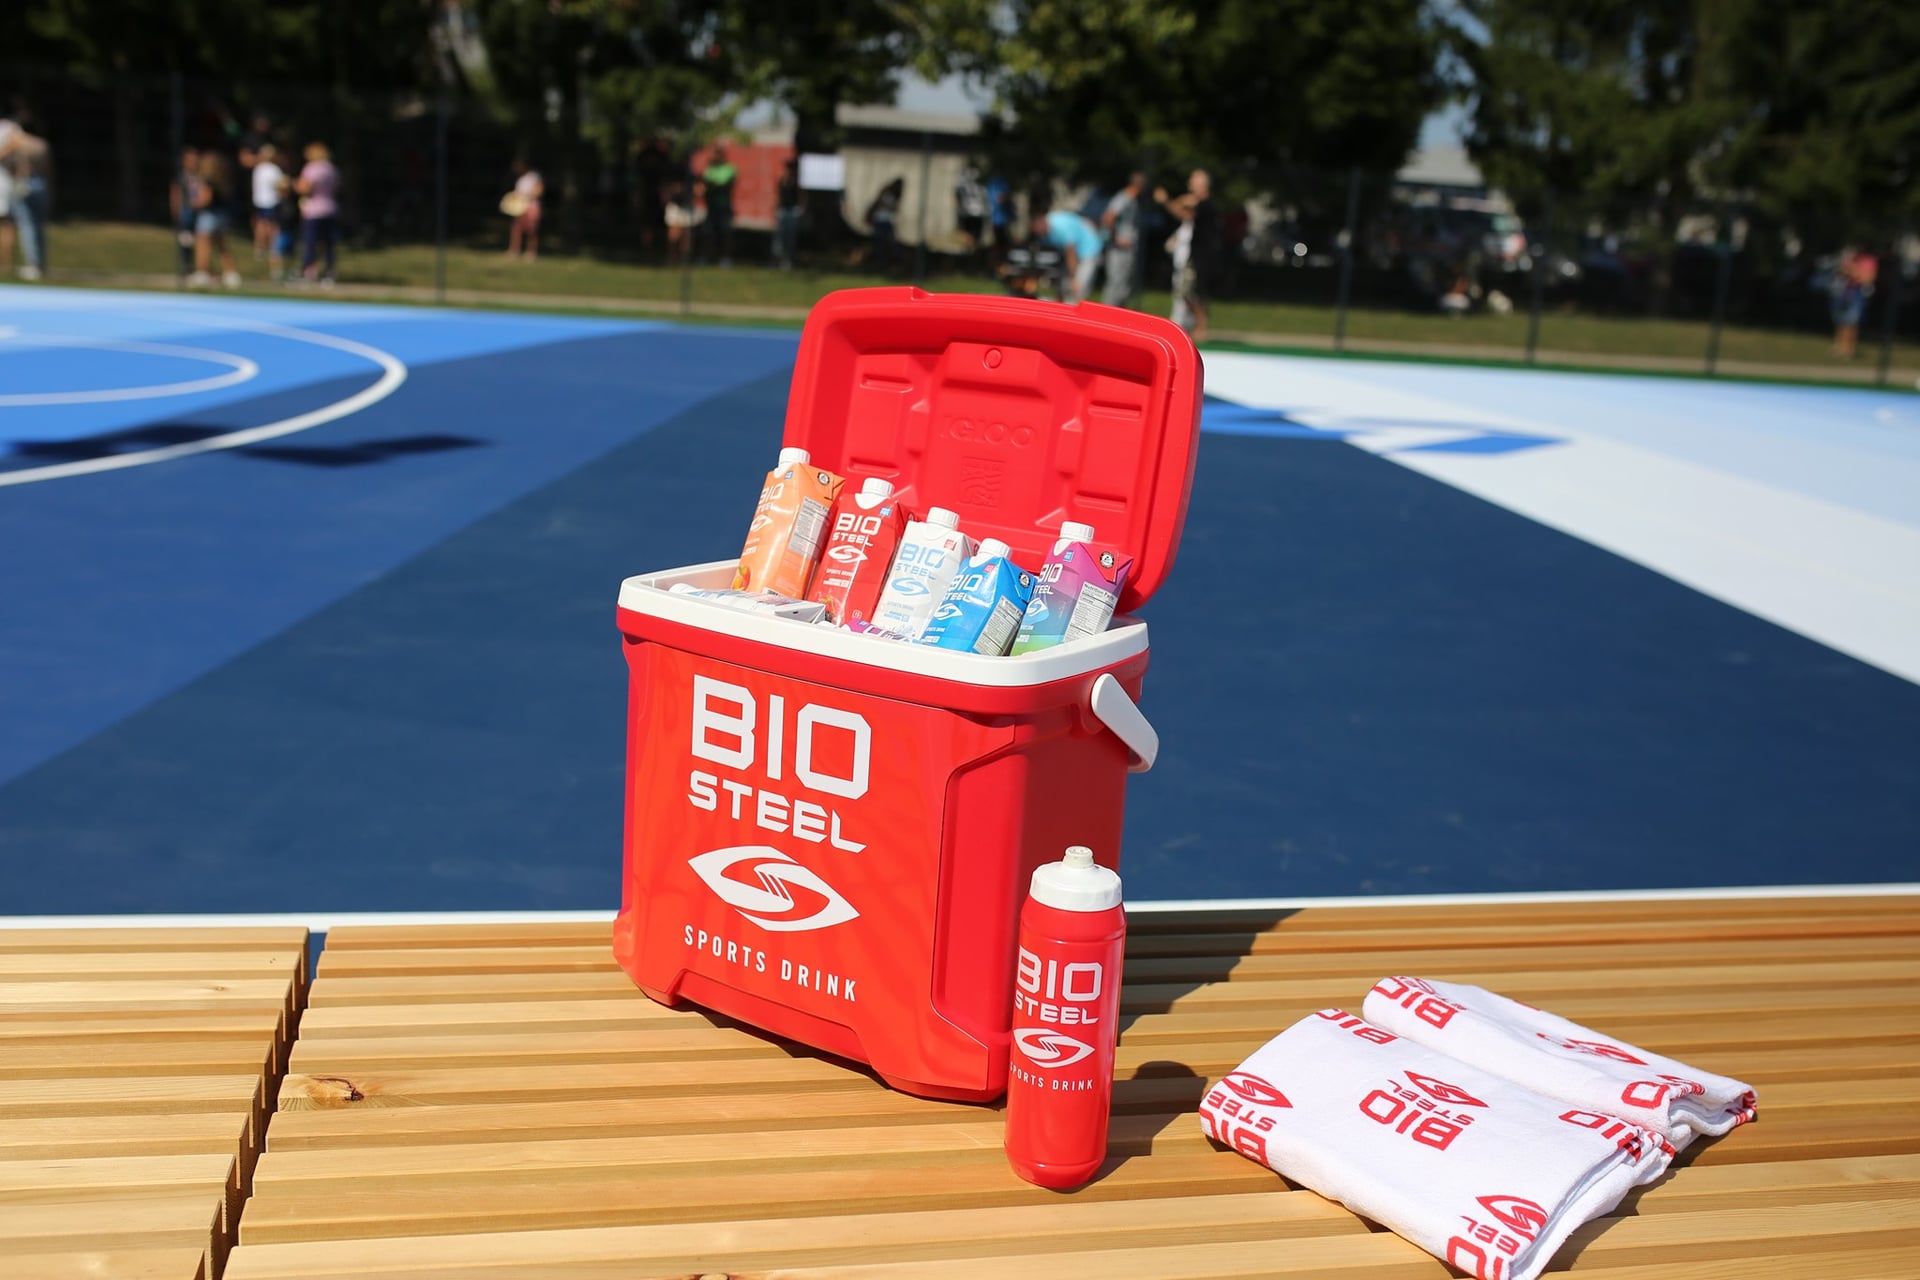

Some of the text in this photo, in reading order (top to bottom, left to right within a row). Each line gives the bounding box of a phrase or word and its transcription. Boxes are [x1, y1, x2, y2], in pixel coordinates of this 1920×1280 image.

[939, 415, 1037, 448] IGLOO
[832, 532, 873, 547] STEEL
[835, 513, 882, 535] BIO
[895, 562, 936, 580] STEEL
[900, 543, 945, 568] BIO
[691, 674, 872, 800] BIO
[688, 770, 867, 853] STEEL
[684, 925, 856, 1002] SPORTS DRINK
[1017, 945, 1103, 1002] BIO
[1014, 989, 1099, 1025] STEEL
[1052, 1079, 1094, 1091] DRINK
[1387, 1079, 1475, 1125] STEEL
[1203, 1090, 1277, 1132] STEE
[1359, 1089, 1464, 1151] BIO
[1460, 1216, 1520, 1256] EEL
